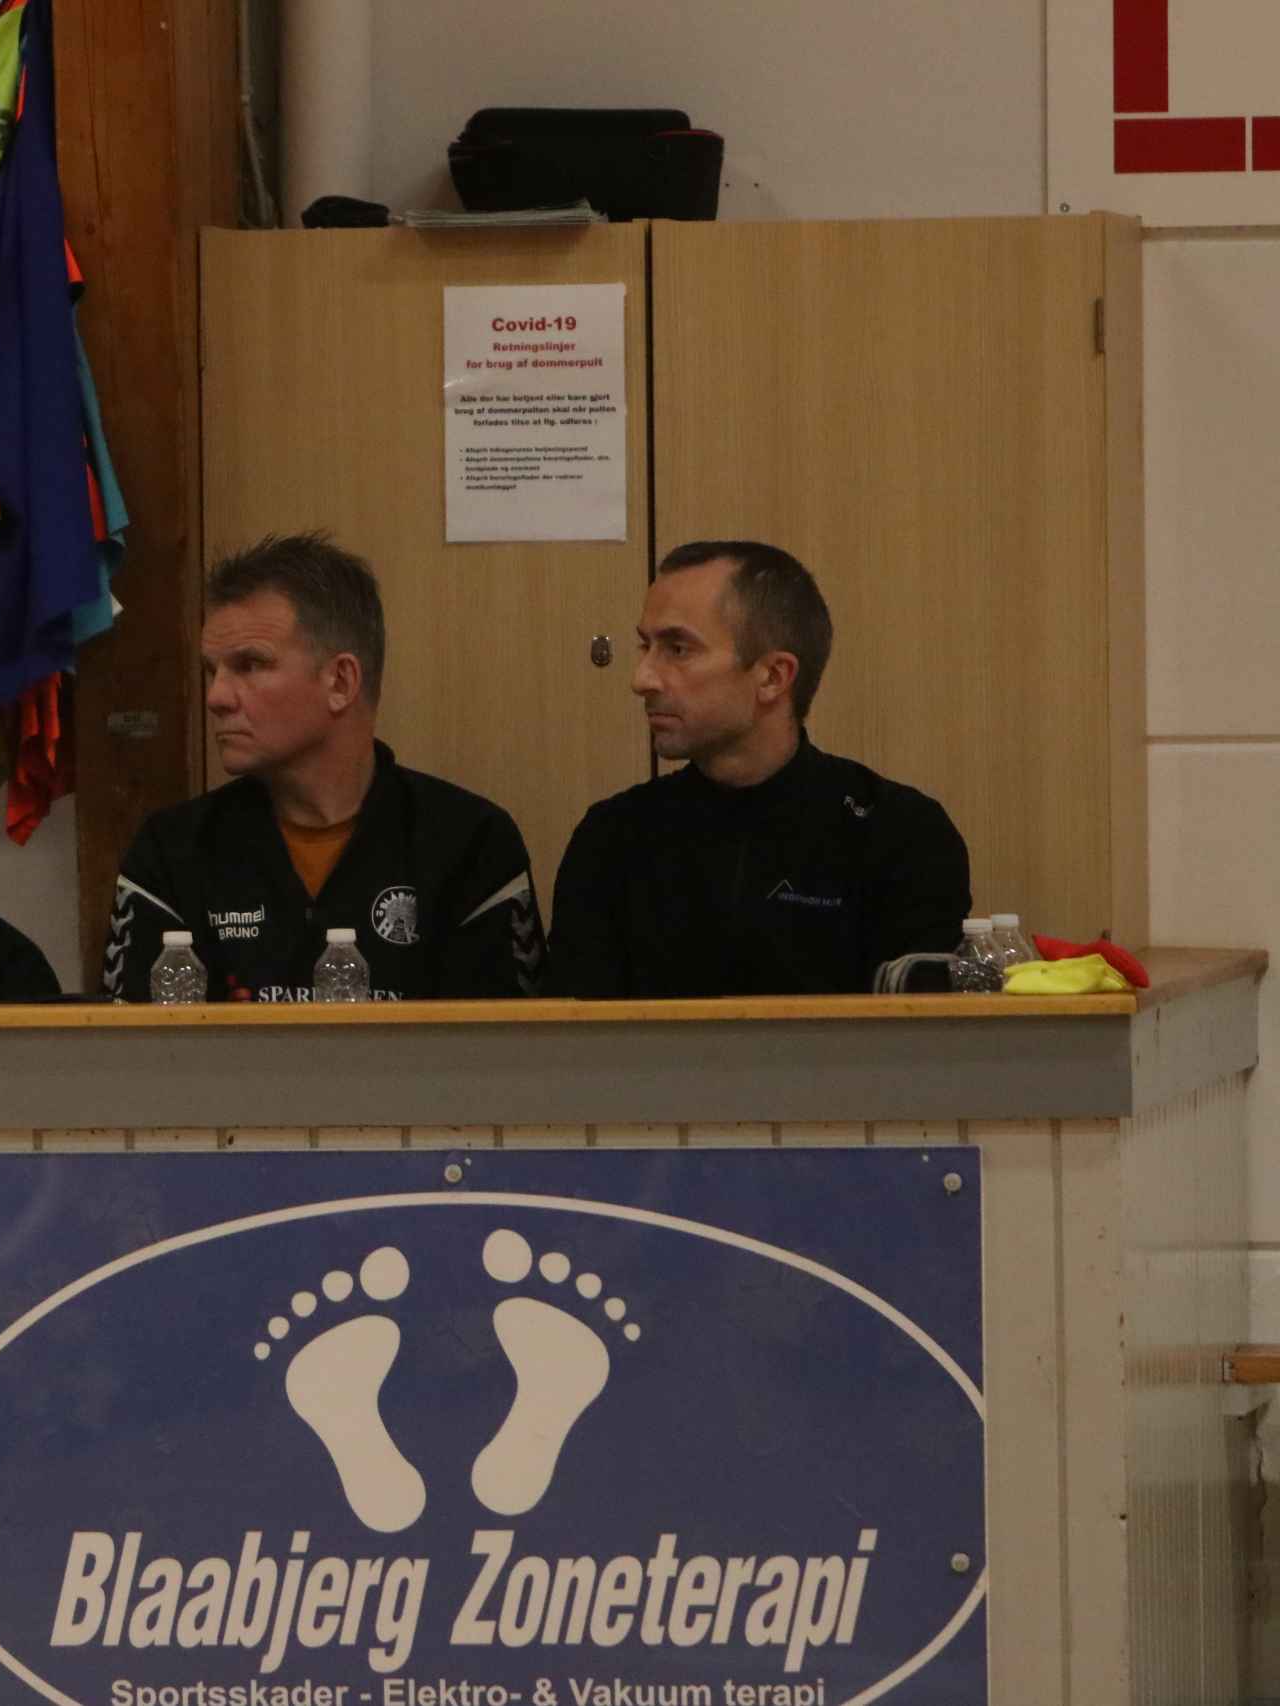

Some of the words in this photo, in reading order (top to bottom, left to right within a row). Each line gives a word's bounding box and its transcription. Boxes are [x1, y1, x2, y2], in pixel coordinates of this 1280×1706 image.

[492, 316, 577, 332] Covid-19
[493, 341, 576, 354] Retningslinjer
[466, 361, 483, 369] for
[486, 360, 513, 371] brug
[517, 360, 528, 369] af
[532, 358, 604, 370] dommerpult
[207, 904, 265, 927] hummel
[218, 926, 259, 940] BRUNO
[50, 1531, 430, 1673] Blaabjerg
[450, 1529, 878, 1673] Zoneterapi
[111, 1679, 349, 1706] Sportsskader
[382, 1678, 522, 1706] Elektro-
[532, 1678, 558, 1706] &
[568, 1678, 712, 1706] Vakuum
[723, 1678, 826, 1706] terapi
